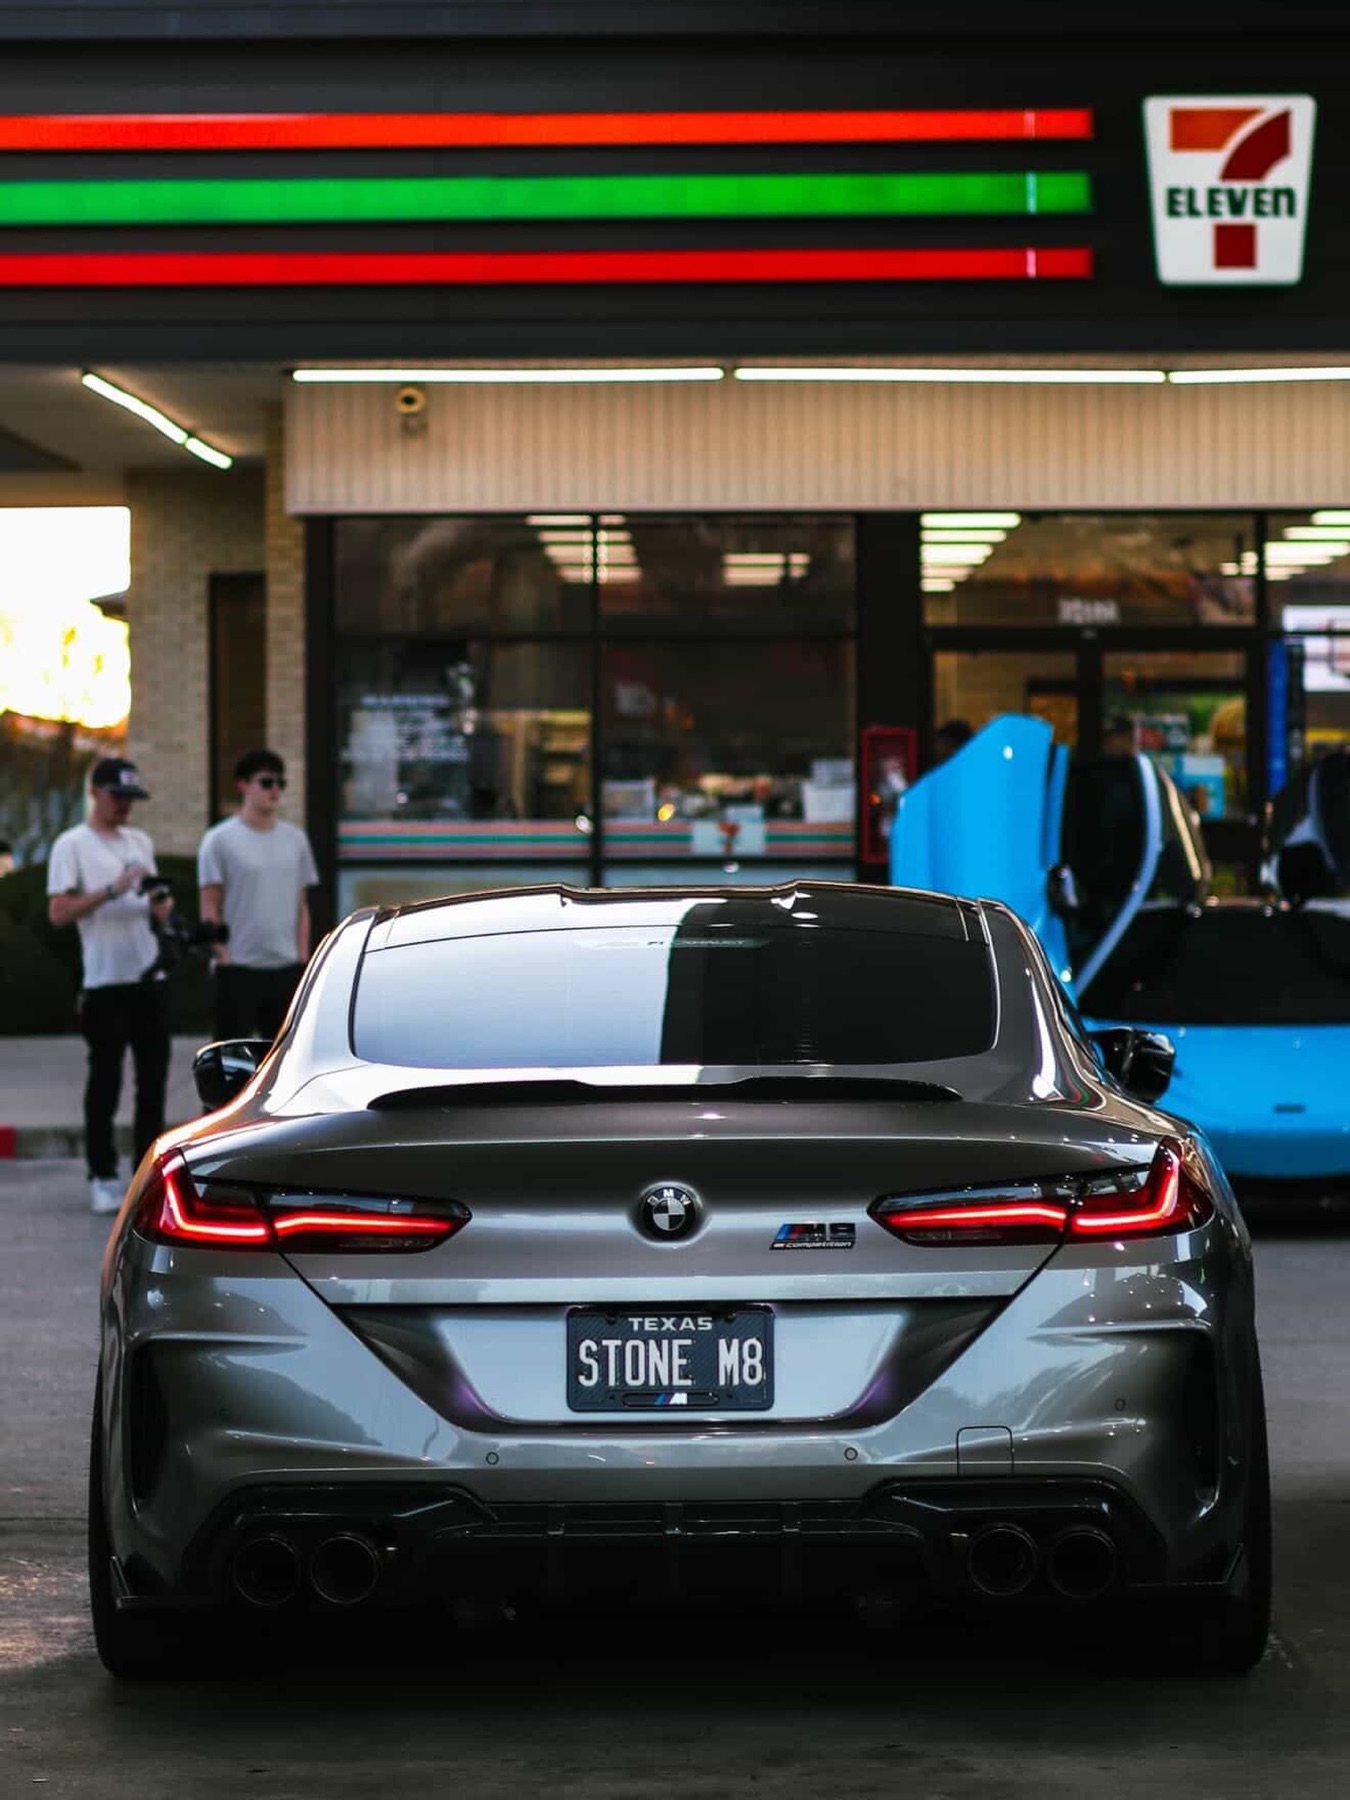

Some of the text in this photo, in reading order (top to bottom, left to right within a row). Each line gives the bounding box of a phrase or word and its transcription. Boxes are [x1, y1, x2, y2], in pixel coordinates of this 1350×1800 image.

[647, 1188, 692, 1206] BMW
[628, 1317, 713, 1331] TEXAS
[577, 1338, 763, 1387] STONE M8
